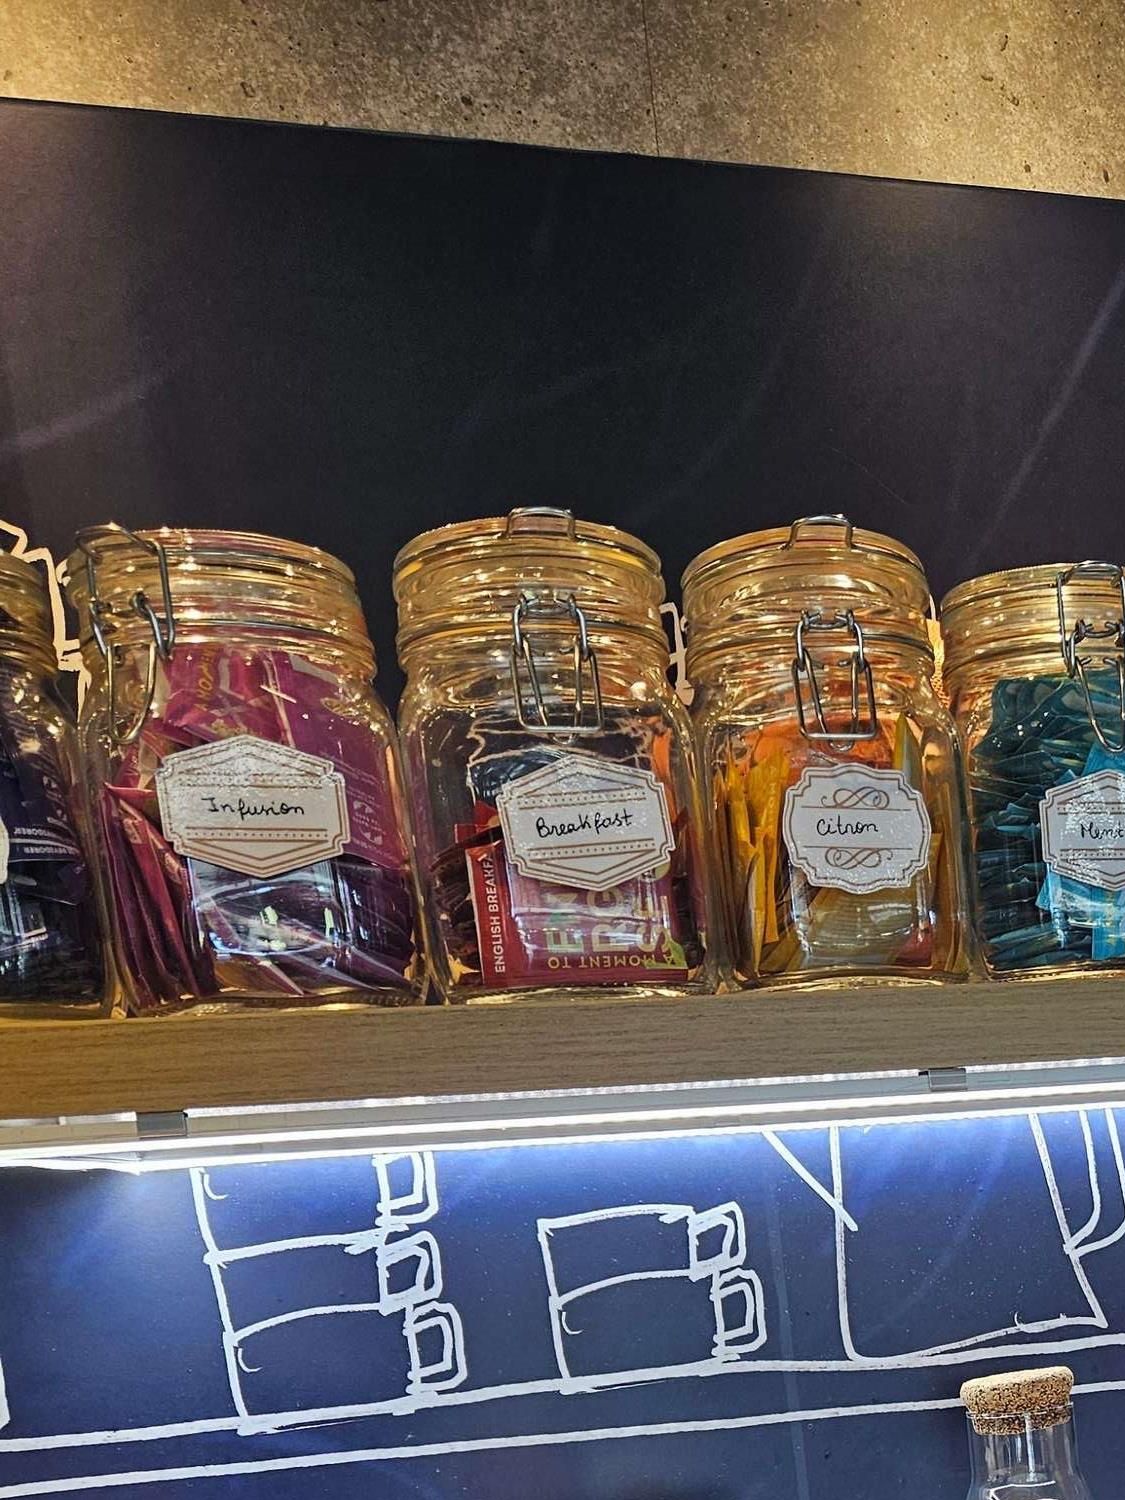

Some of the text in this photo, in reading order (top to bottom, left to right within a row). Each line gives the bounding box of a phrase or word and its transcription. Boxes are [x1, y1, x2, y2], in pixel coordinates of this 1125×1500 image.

[201, 797, 305, 821] Infusion
[535, 808, 633, 838] Breakfast
[816, 814, 879, 836] Citron
[488, 914, 506, 973] ENGLISH
[547, 956, 574, 969] TO
